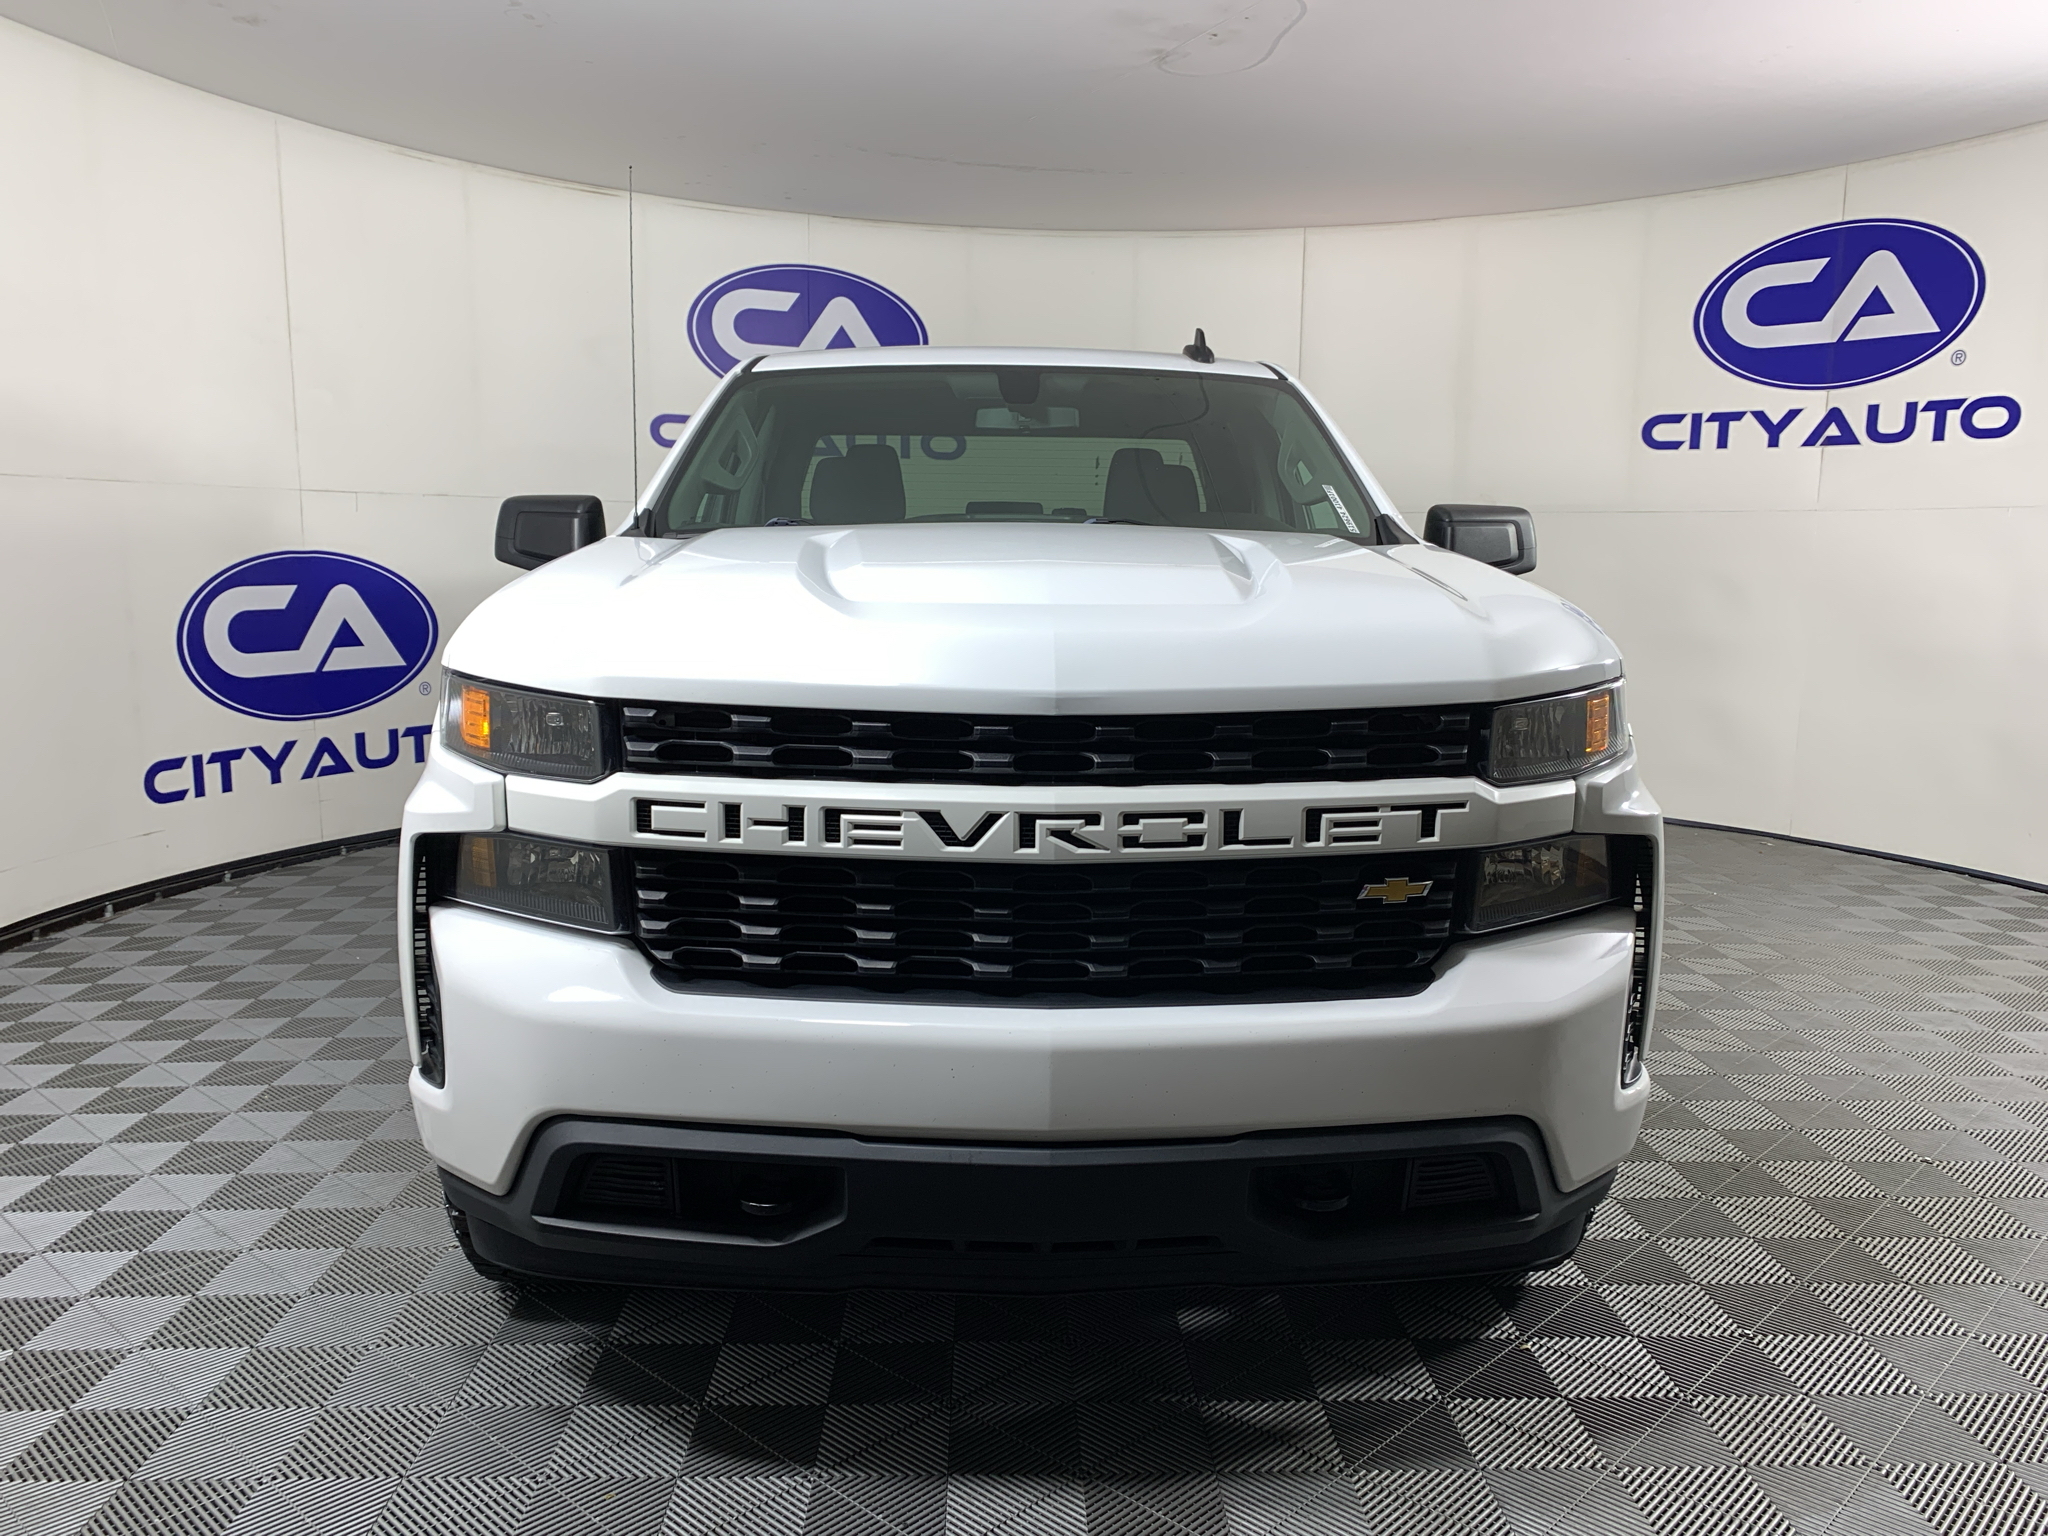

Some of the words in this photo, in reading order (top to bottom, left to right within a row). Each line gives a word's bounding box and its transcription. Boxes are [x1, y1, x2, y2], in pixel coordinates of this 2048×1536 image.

[1721, 249, 1942, 349] CA
[203, 583, 407, 679] CA
[300, 724, 433, 781] AUT
[631, 797, 1470, 853] CHEVROLET
